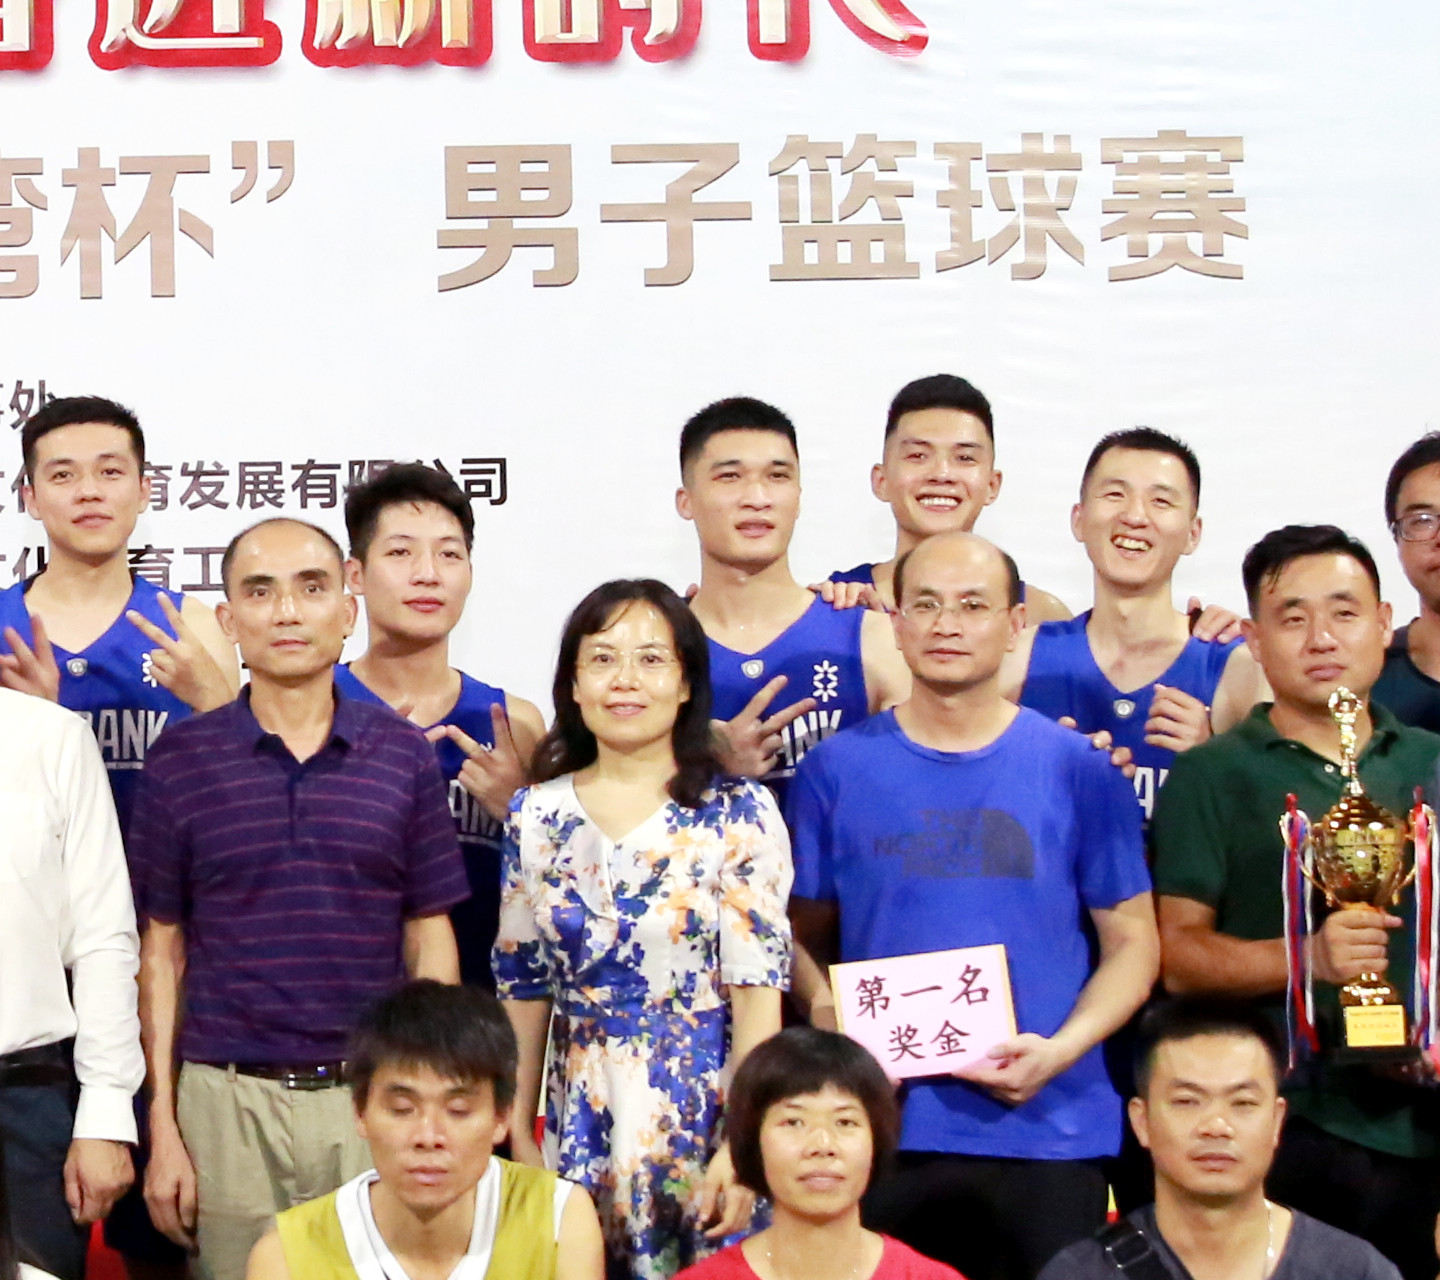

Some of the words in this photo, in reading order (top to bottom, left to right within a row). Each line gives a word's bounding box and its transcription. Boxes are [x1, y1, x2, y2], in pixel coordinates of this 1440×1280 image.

[436, 128, 1250, 293] 男子篮球赛
[854, 964, 991, 1020] 第一名
[887, 1019, 971, 1063] 奖金
